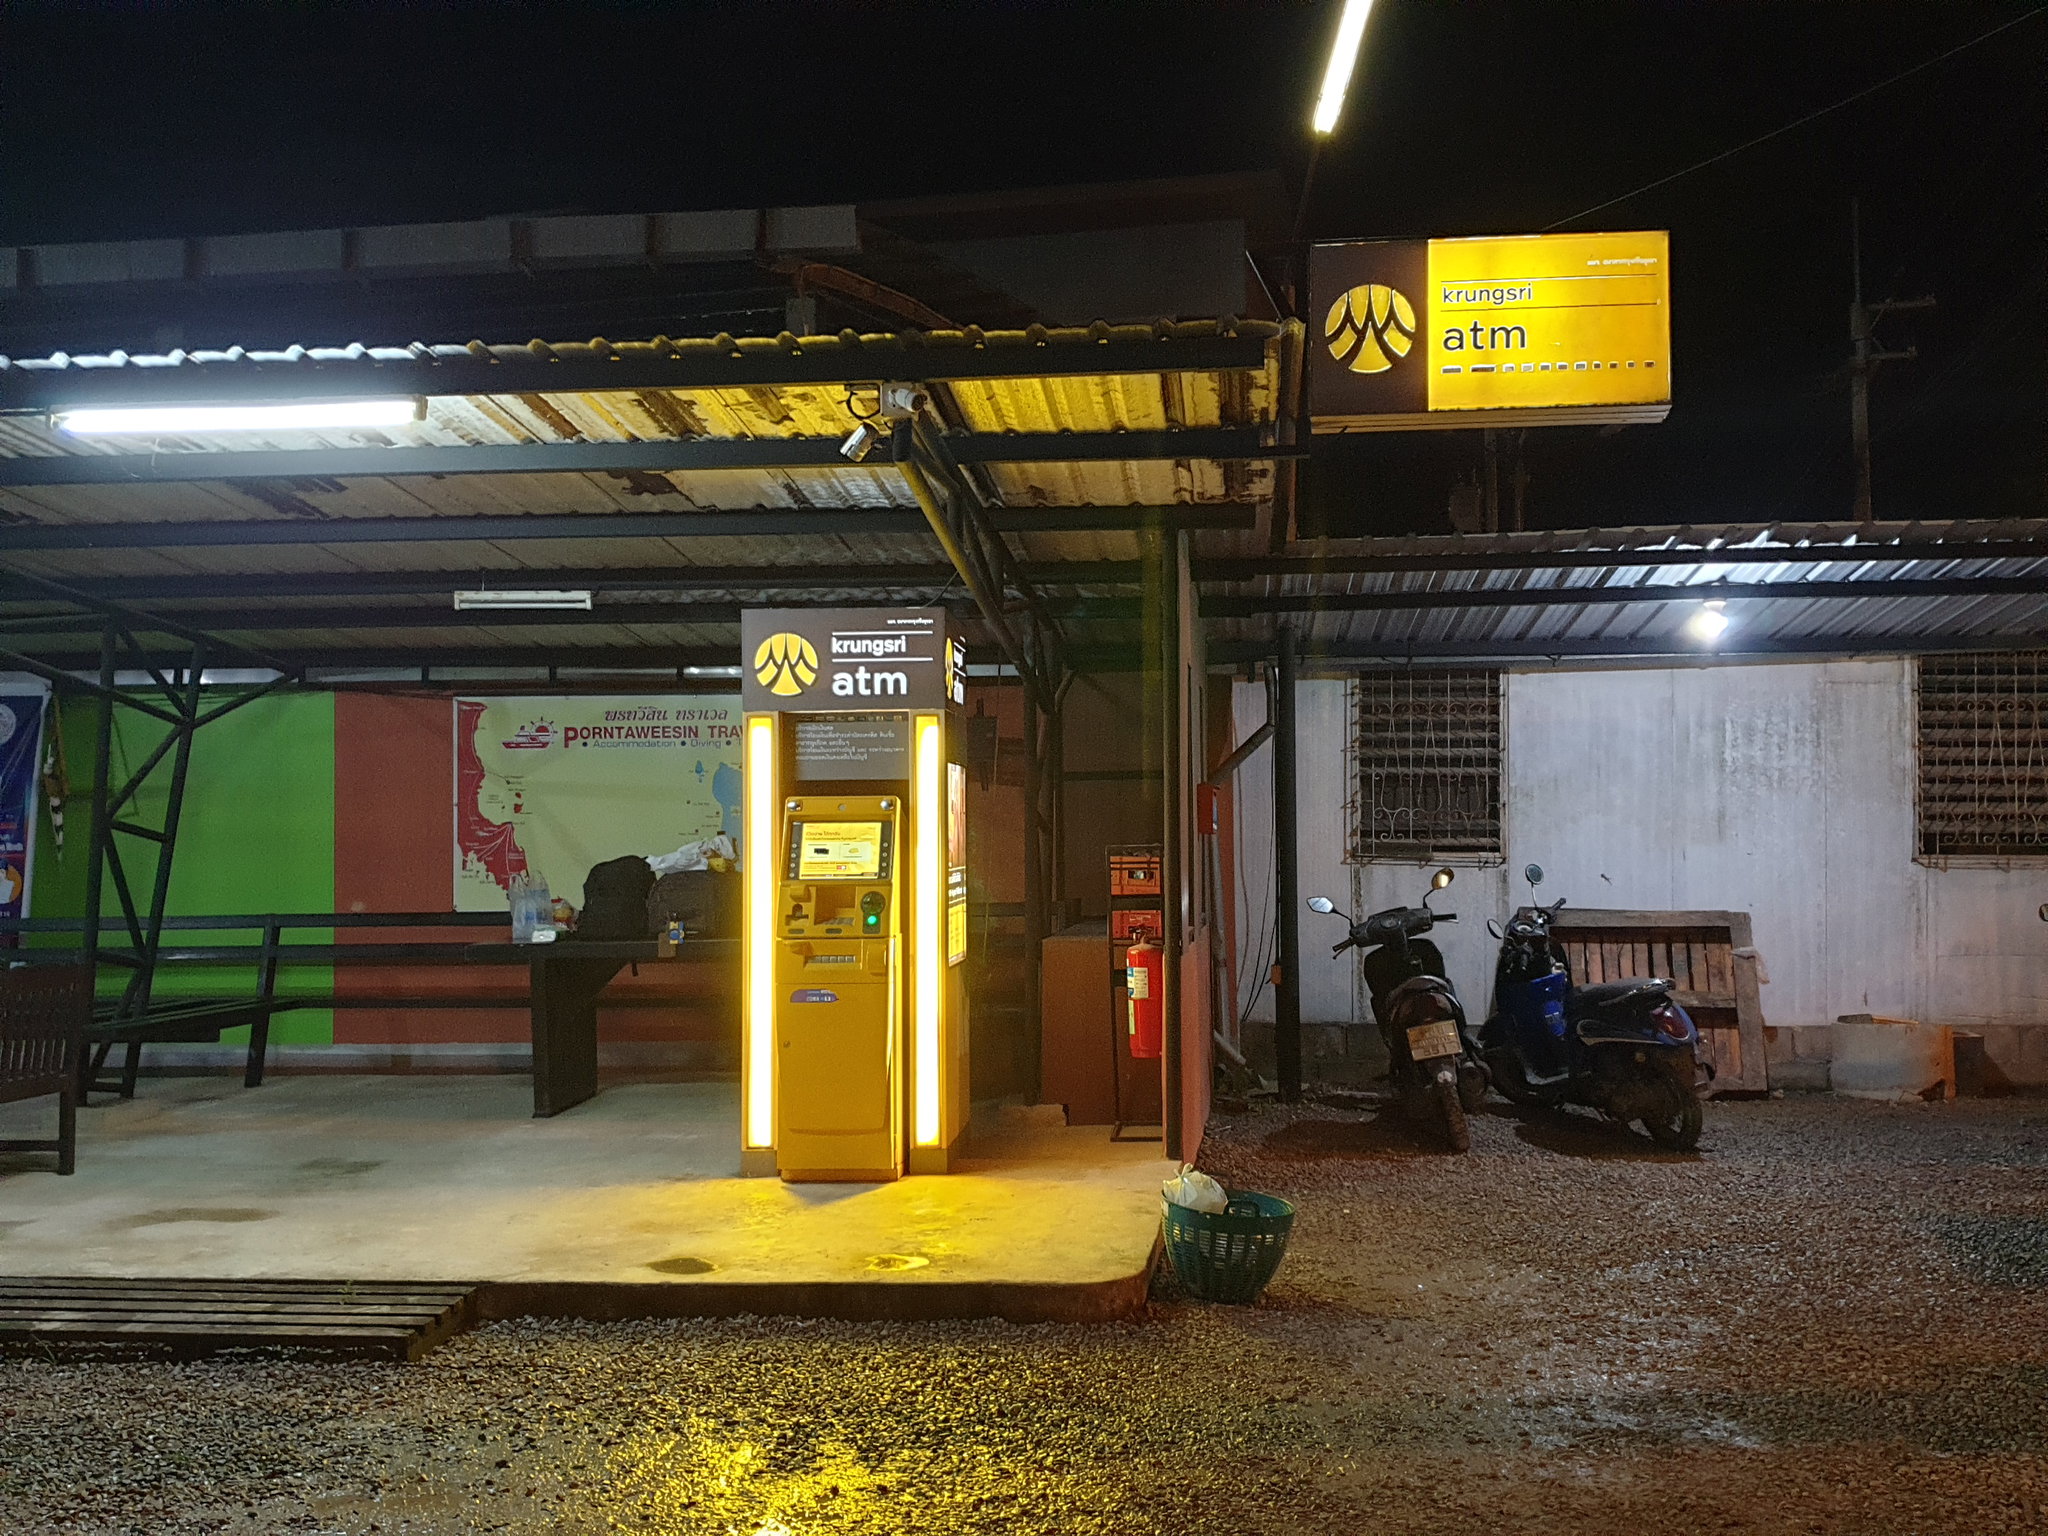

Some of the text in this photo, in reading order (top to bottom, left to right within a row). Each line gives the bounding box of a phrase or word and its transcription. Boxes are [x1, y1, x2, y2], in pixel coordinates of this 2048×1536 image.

[1442, 282, 1533, 305] krungsri
[1442, 320, 1527, 351] atm
[831, 635, 907, 657] krungsri
[832, 666, 908, 697] atm
[564, 725, 699, 749] PORNTAWEESIN
[593, 739, 722, 749] Accommodation Diving
